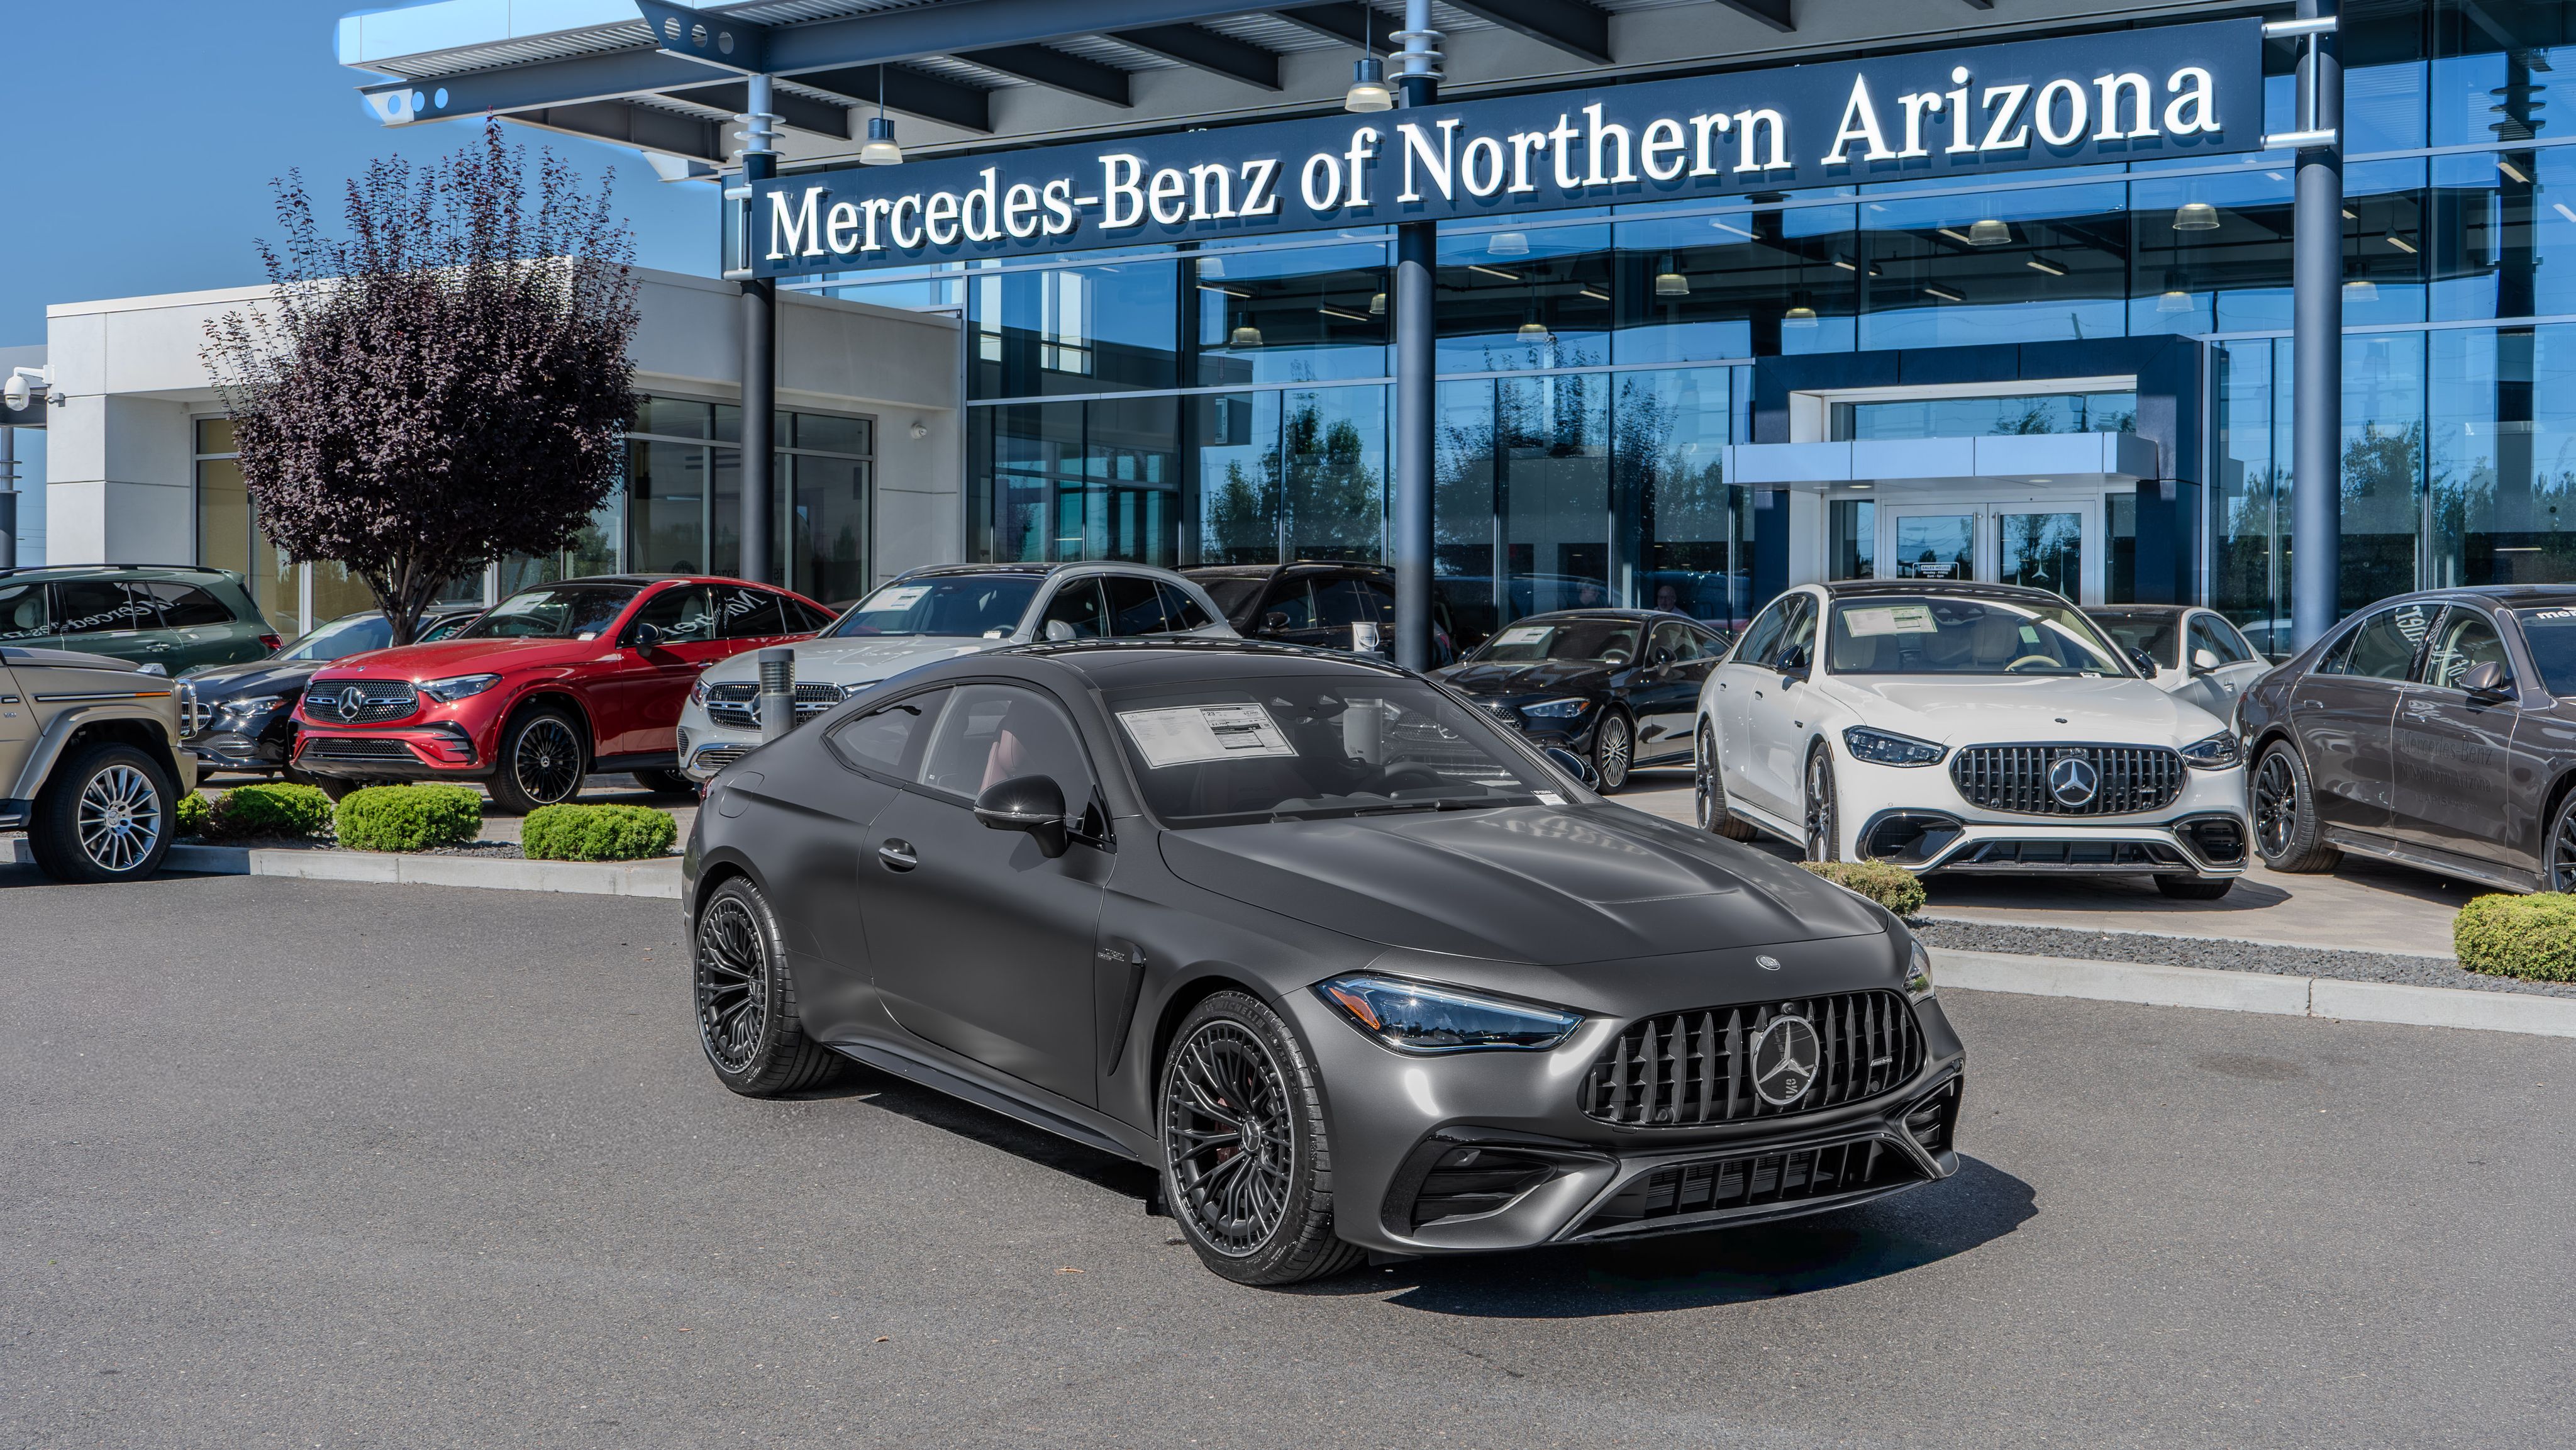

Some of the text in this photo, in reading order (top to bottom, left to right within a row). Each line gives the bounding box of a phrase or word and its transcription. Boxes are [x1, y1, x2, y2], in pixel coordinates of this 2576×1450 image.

[765, 66, 2221, 260] Mercedes-Benz of Northern Arizona
[2401, 729, 2493, 766] Mercedes-Benz
[2411, 763, 2451, 786] Northern
[2455, 769, 2492, 792] Arizona
[1291, 1082, 1299, 1095] 20
